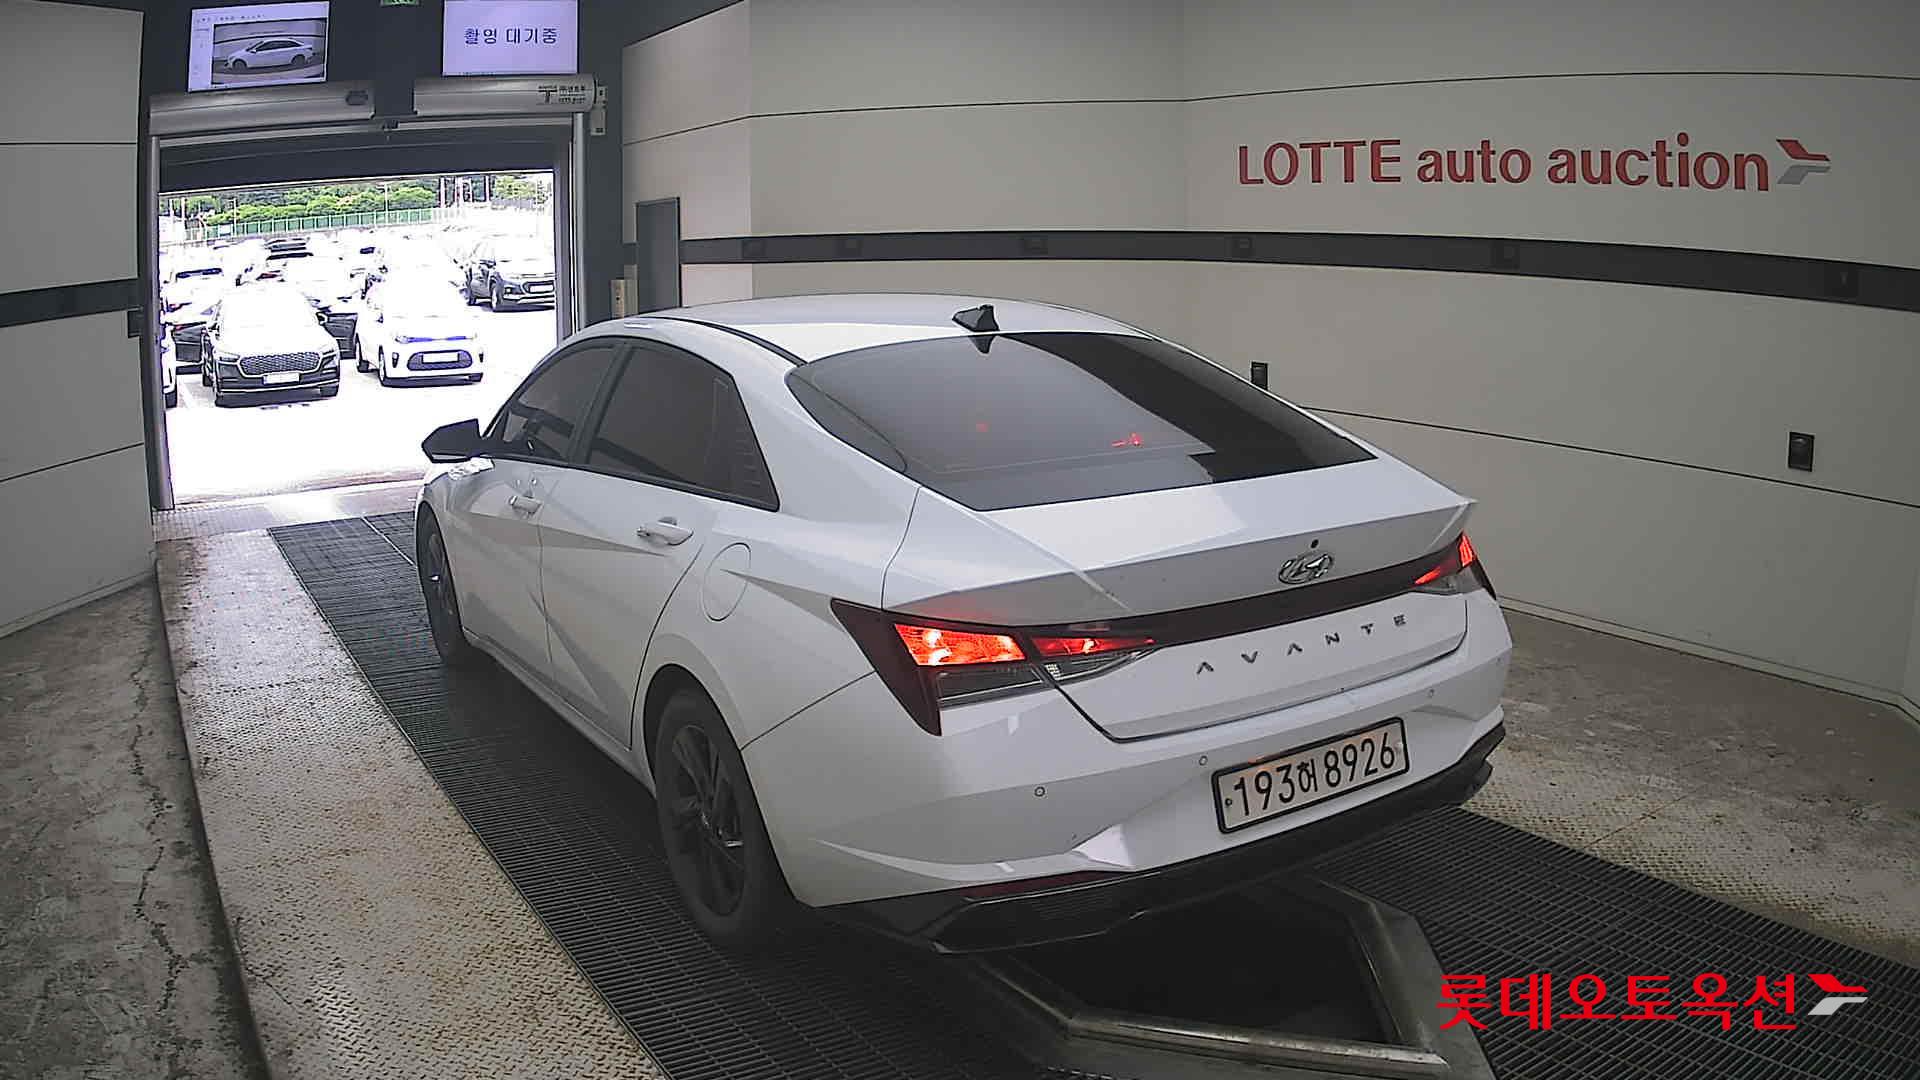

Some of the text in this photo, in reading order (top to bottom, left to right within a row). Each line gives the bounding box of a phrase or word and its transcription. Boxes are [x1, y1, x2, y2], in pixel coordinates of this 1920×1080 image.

[506, 27, 557, 45] 대기중
[1239, 132, 1769, 191] LOTTE auto auction
[1196, 614, 1407, 675] AVANTE
